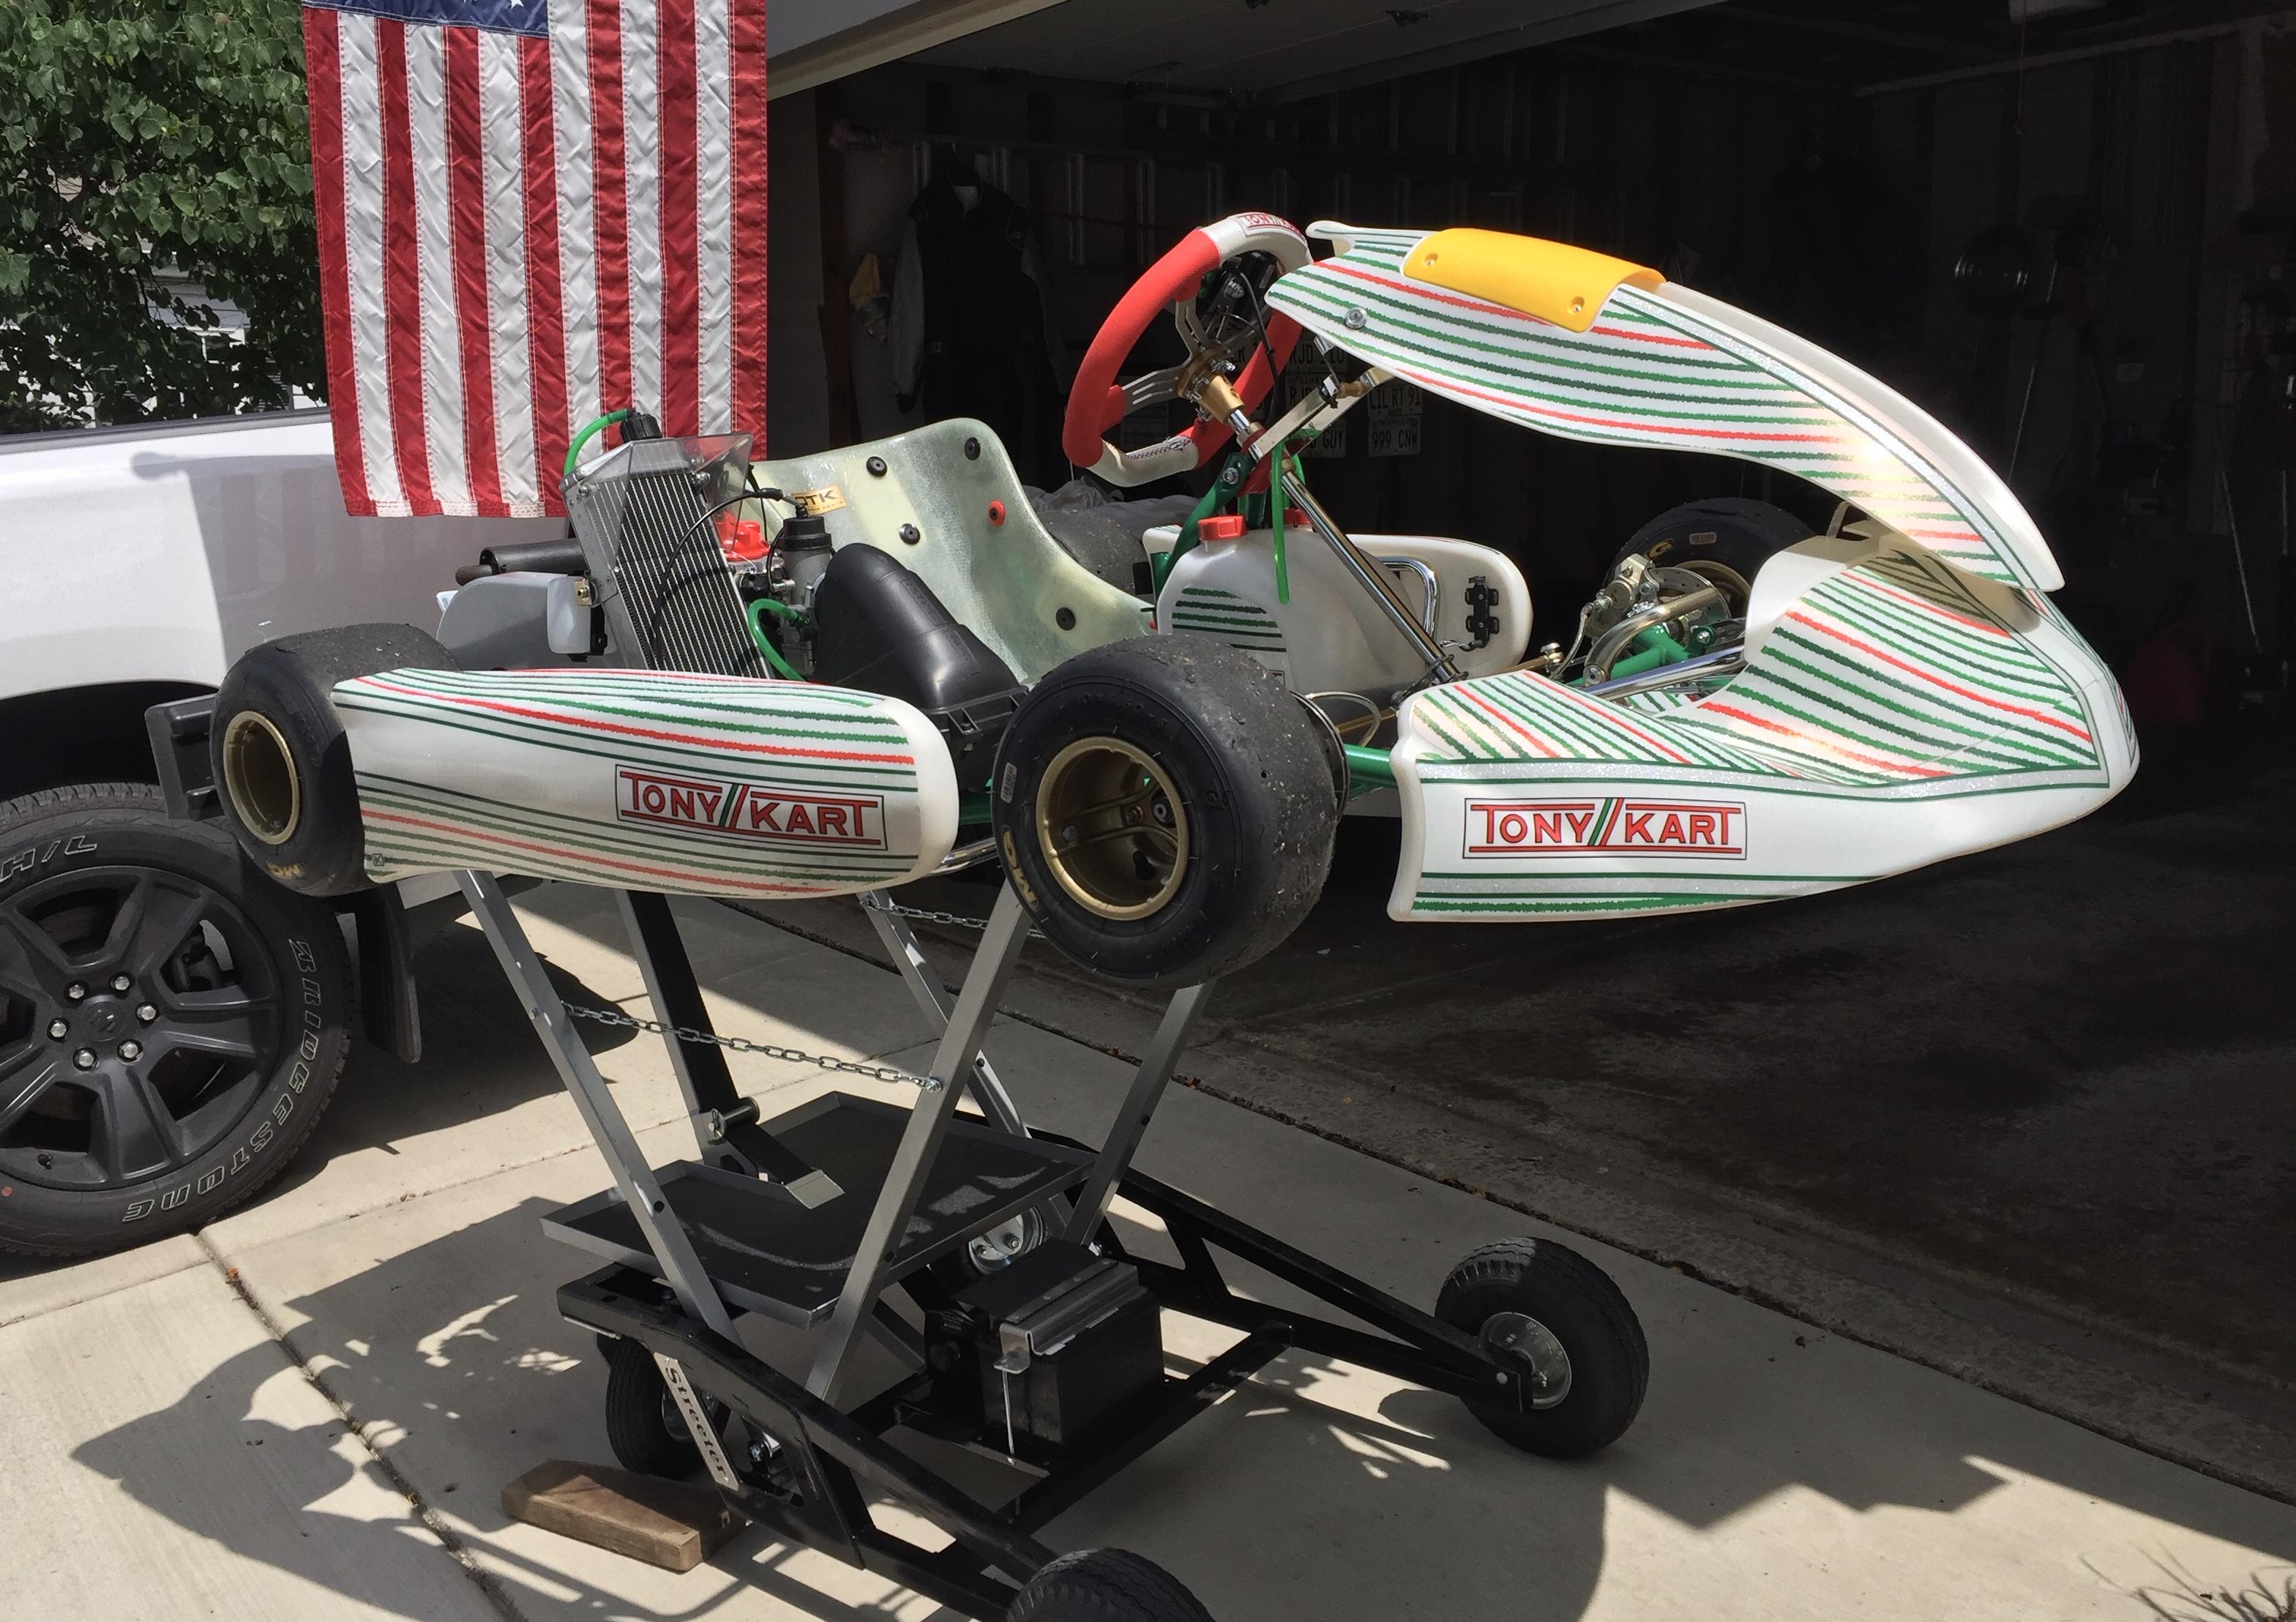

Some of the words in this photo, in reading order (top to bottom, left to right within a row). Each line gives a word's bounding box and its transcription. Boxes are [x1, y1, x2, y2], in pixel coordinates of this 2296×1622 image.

[1391, 386, 1405, 408] RT
[1323, 428, 1345, 449] GUY
[1372, 430, 1392, 450] 999
[619, 771, 723, 823] TONY
[749, 791, 880, 838] KART
[1470, 803, 1596, 845] TONY
[1625, 803, 1742, 845] KART
[121, 938, 321, 1222] BRIDGESTONE
[665, 1367, 727, 1476] Streeter
